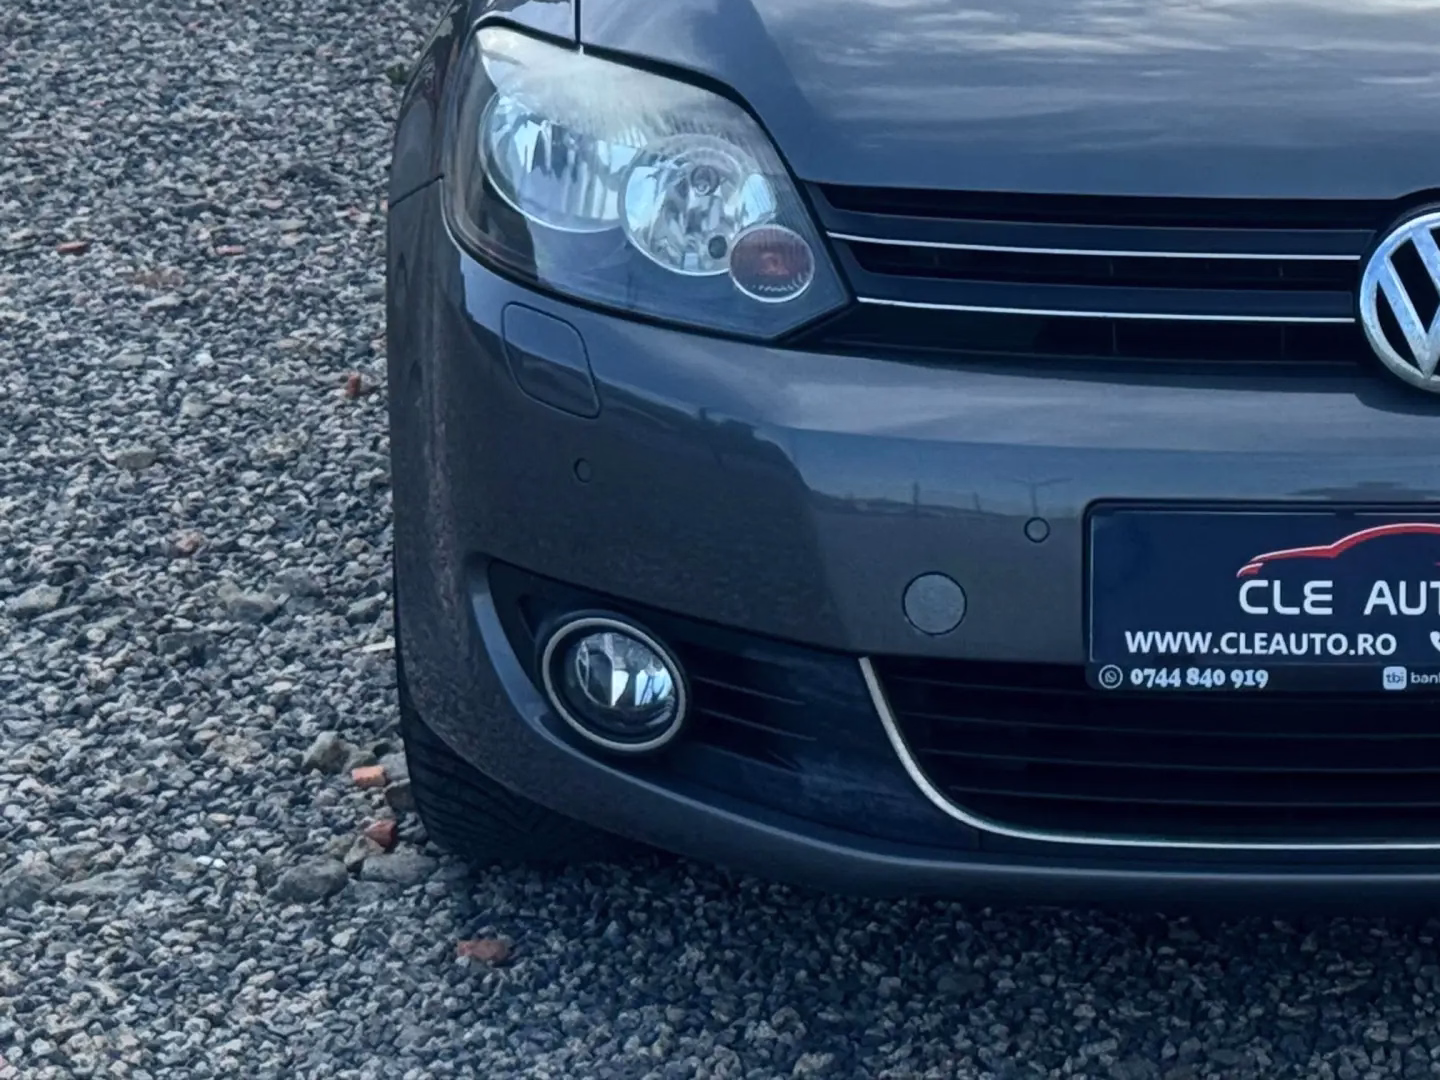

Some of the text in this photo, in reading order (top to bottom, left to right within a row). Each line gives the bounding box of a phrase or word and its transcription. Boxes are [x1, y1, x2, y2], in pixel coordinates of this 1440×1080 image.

[1238, 579, 1334, 616] CLE
[1124, 630, 1398, 656] WWW.CLEAUTO.RO
[1129, 667, 1270, 689] 0744 840 919
